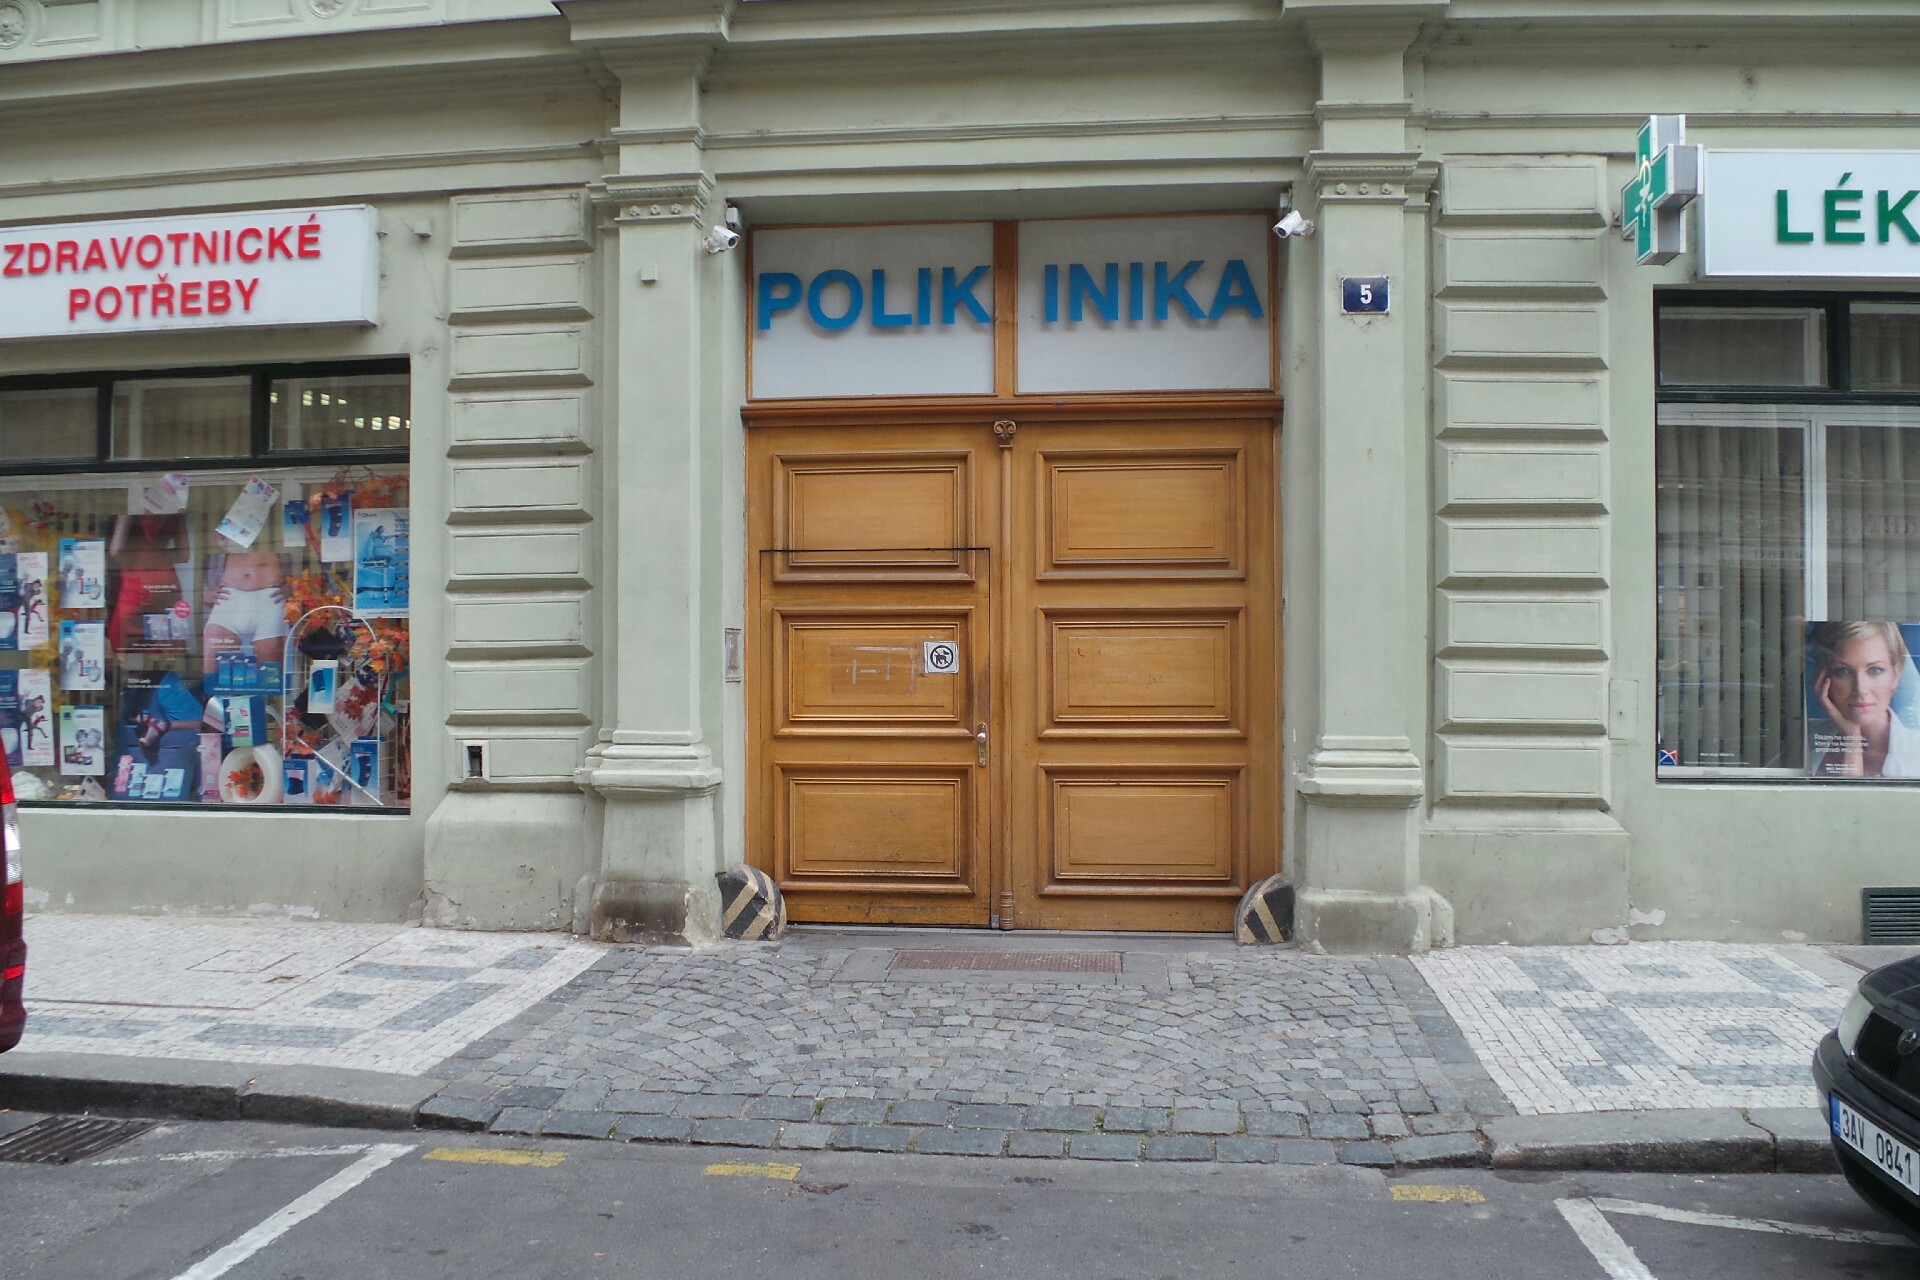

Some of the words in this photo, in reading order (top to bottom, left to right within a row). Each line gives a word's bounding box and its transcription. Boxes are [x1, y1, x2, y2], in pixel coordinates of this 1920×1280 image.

[1776, 172, 1920, 244] LÉK
[2, 213, 321, 277] ZDRAVOTNICKÉ
[68, 274, 260, 321] POTŘEBY
[757, 265, 992, 331] POLIK
[1044, 258, 1264, 323] INIKA
[1360, 284, 1373, 304] 5
[1842, 1107, 1865, 1151] 3AV
[1876, 1131, 1912, 1185] 0841
